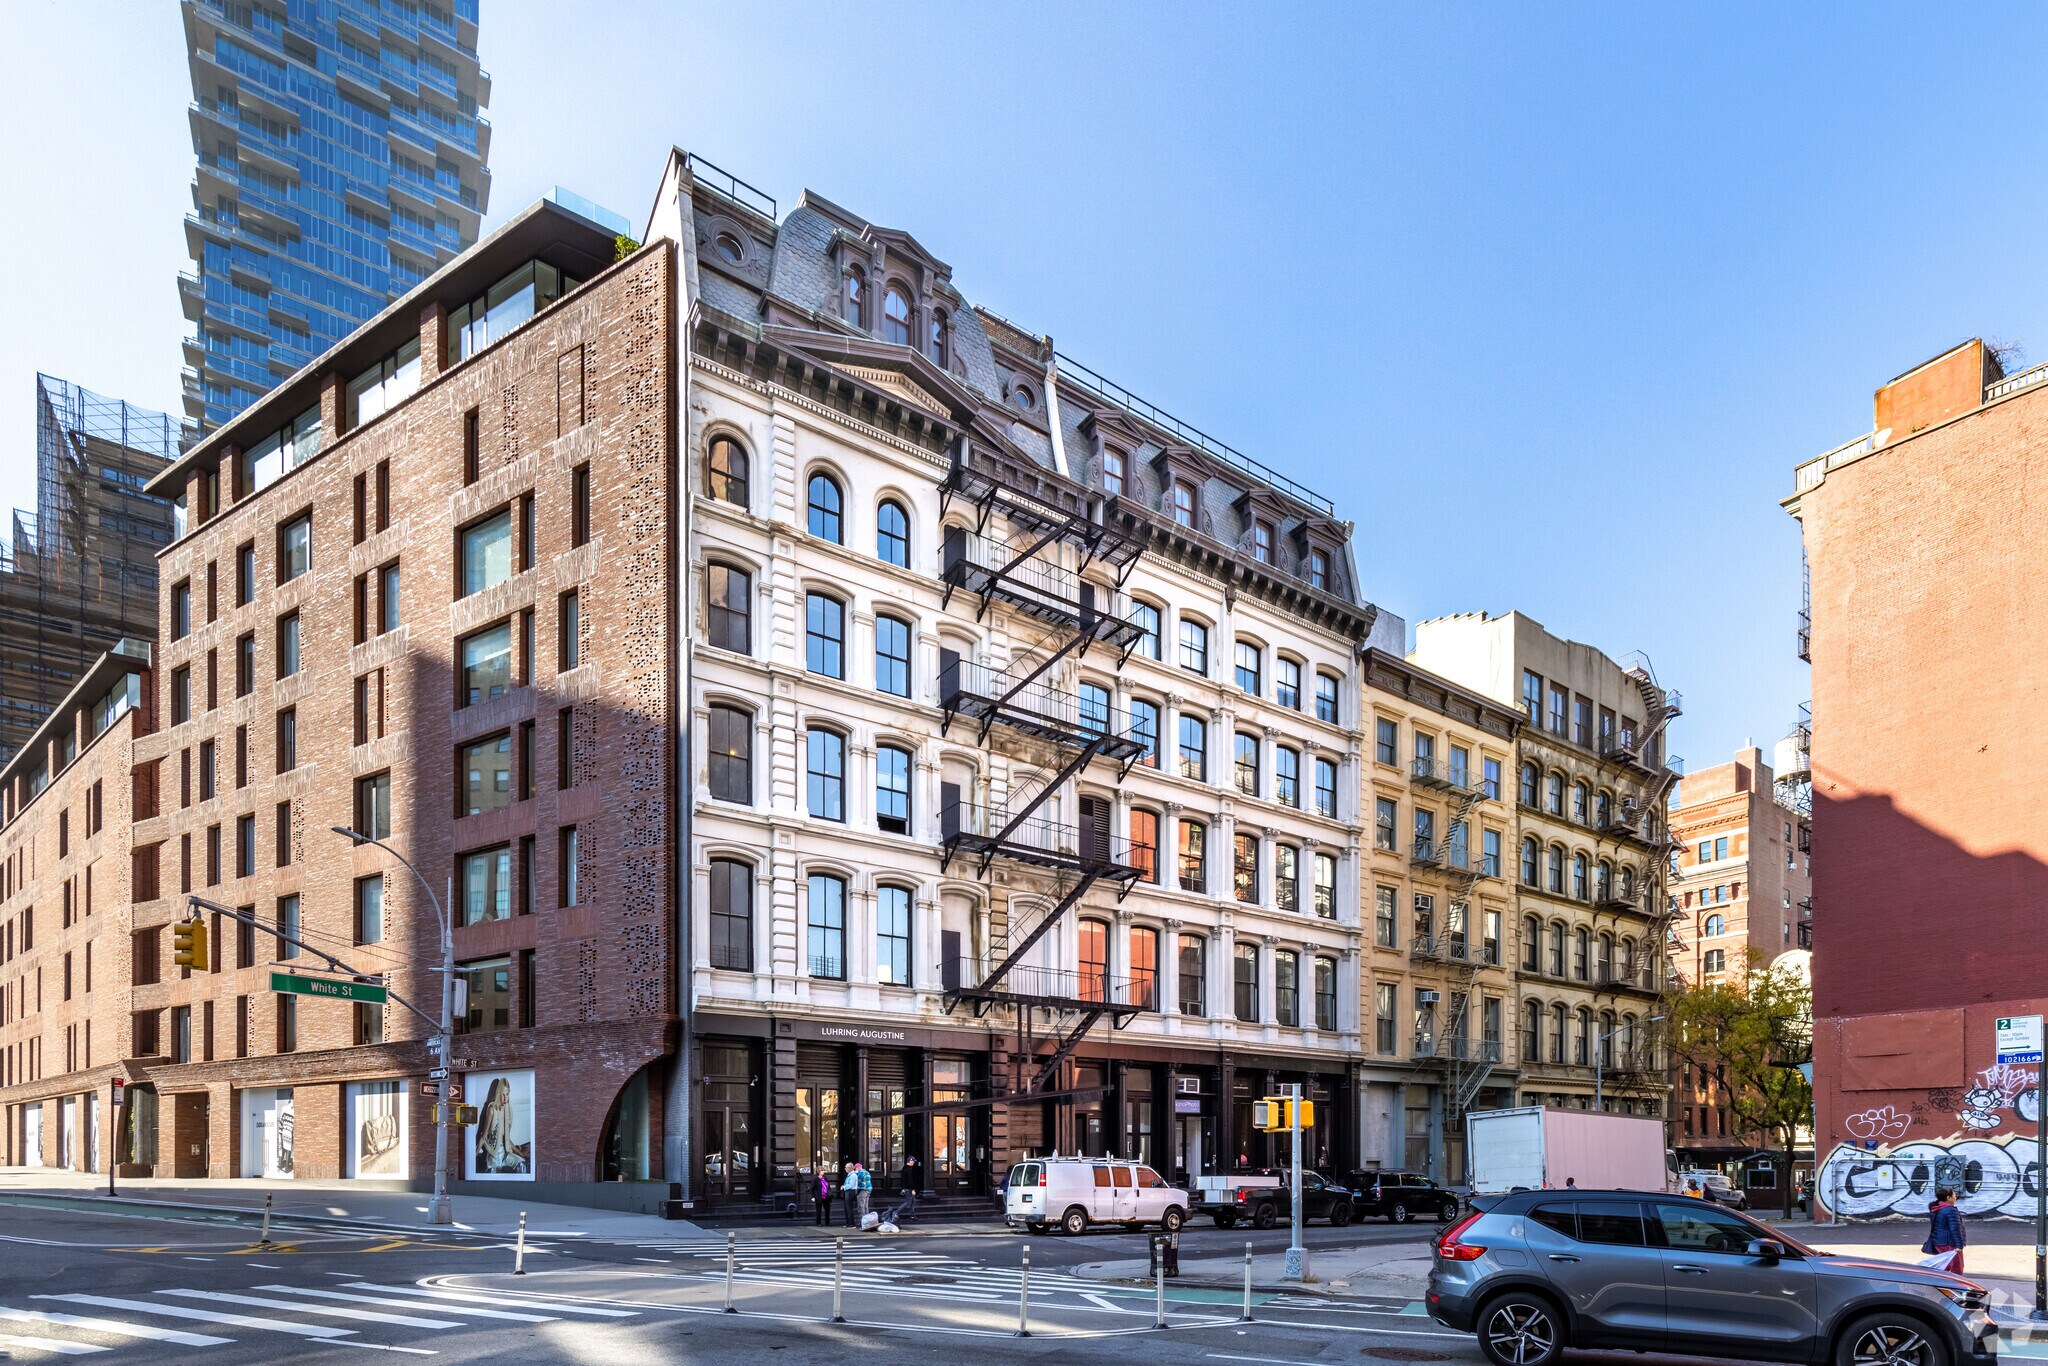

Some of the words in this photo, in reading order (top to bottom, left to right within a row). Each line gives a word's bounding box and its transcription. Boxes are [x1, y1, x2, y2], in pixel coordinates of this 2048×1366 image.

[310, 982, 338, 995] White
[342, 986, 353, 996] St
[2000, 1020, 2008, 1029] 2
[821, 1028, 858, 1037] LUHRING
[859, 1030, 905, 1040] AUGUSTINE
[452, 1058, 467, 1066] WHITE
[470, 1060, 478, 1068] ST
